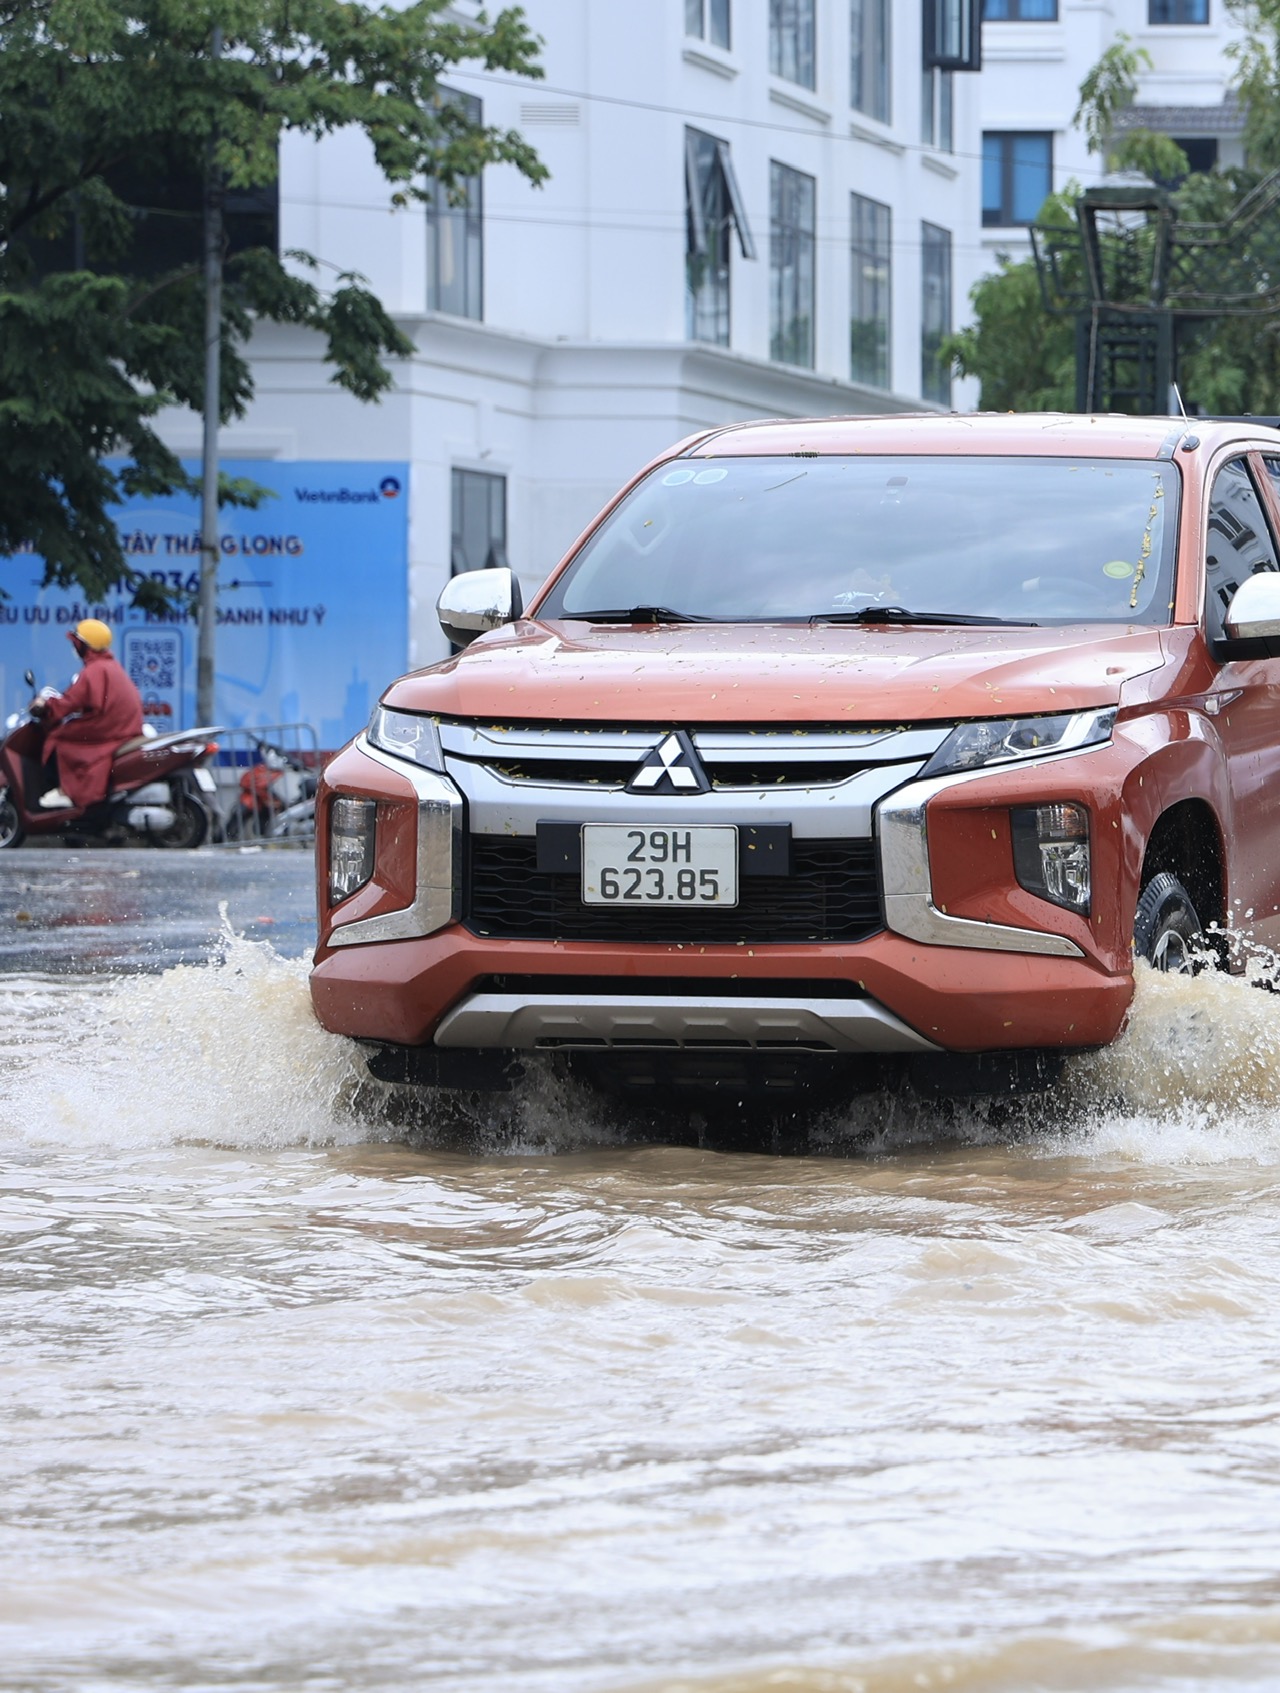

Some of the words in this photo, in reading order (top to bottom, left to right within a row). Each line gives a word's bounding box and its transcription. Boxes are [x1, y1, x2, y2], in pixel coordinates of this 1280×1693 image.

[294, 487, 379, 503] VietinBank
[122, 530, 162, 554] TÂY
[165, 530, 238, 555] THẮG
[242, 535, 303, 555] LONG
[269, 607, 309, 624] NHƯ
[627, 831, 691, 863] 29H
[600, 868, 719, 901] 623.85
